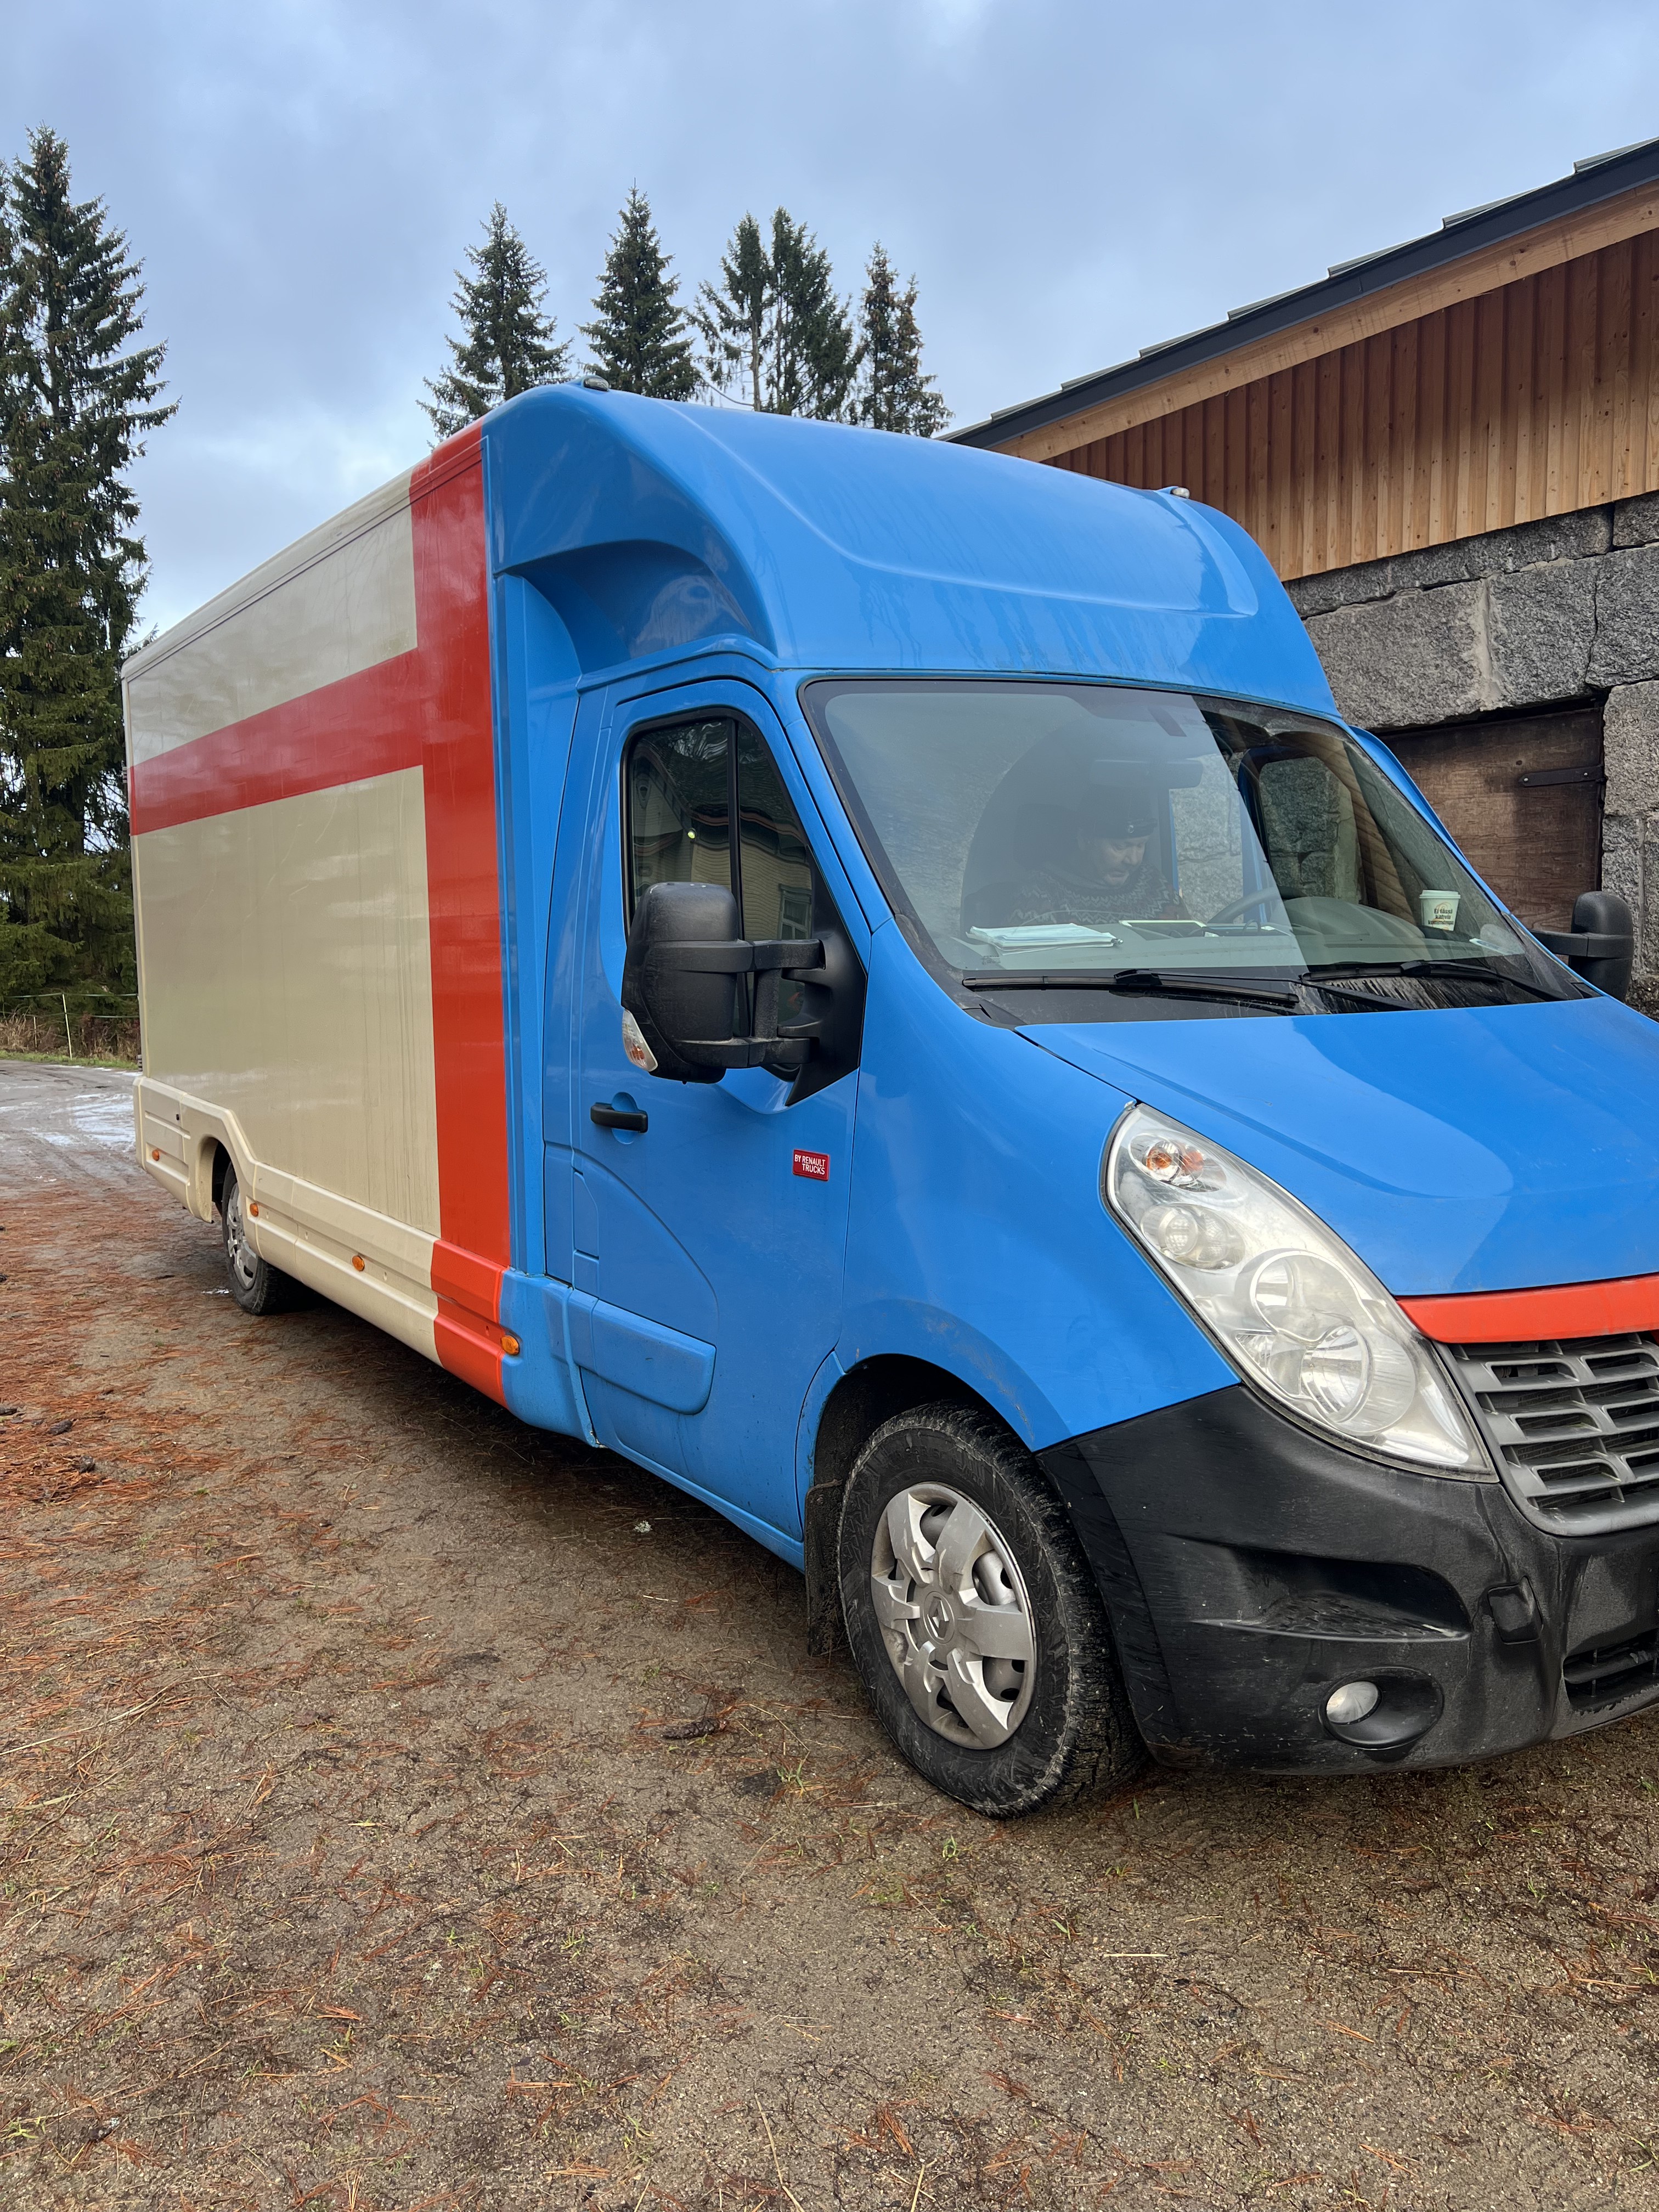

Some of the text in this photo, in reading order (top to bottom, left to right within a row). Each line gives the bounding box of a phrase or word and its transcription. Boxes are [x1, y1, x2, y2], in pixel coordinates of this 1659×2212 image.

[794, 1154, 826, 1167] BY RENAULT
[802, 1164, 825, 1175] TRUCKS
